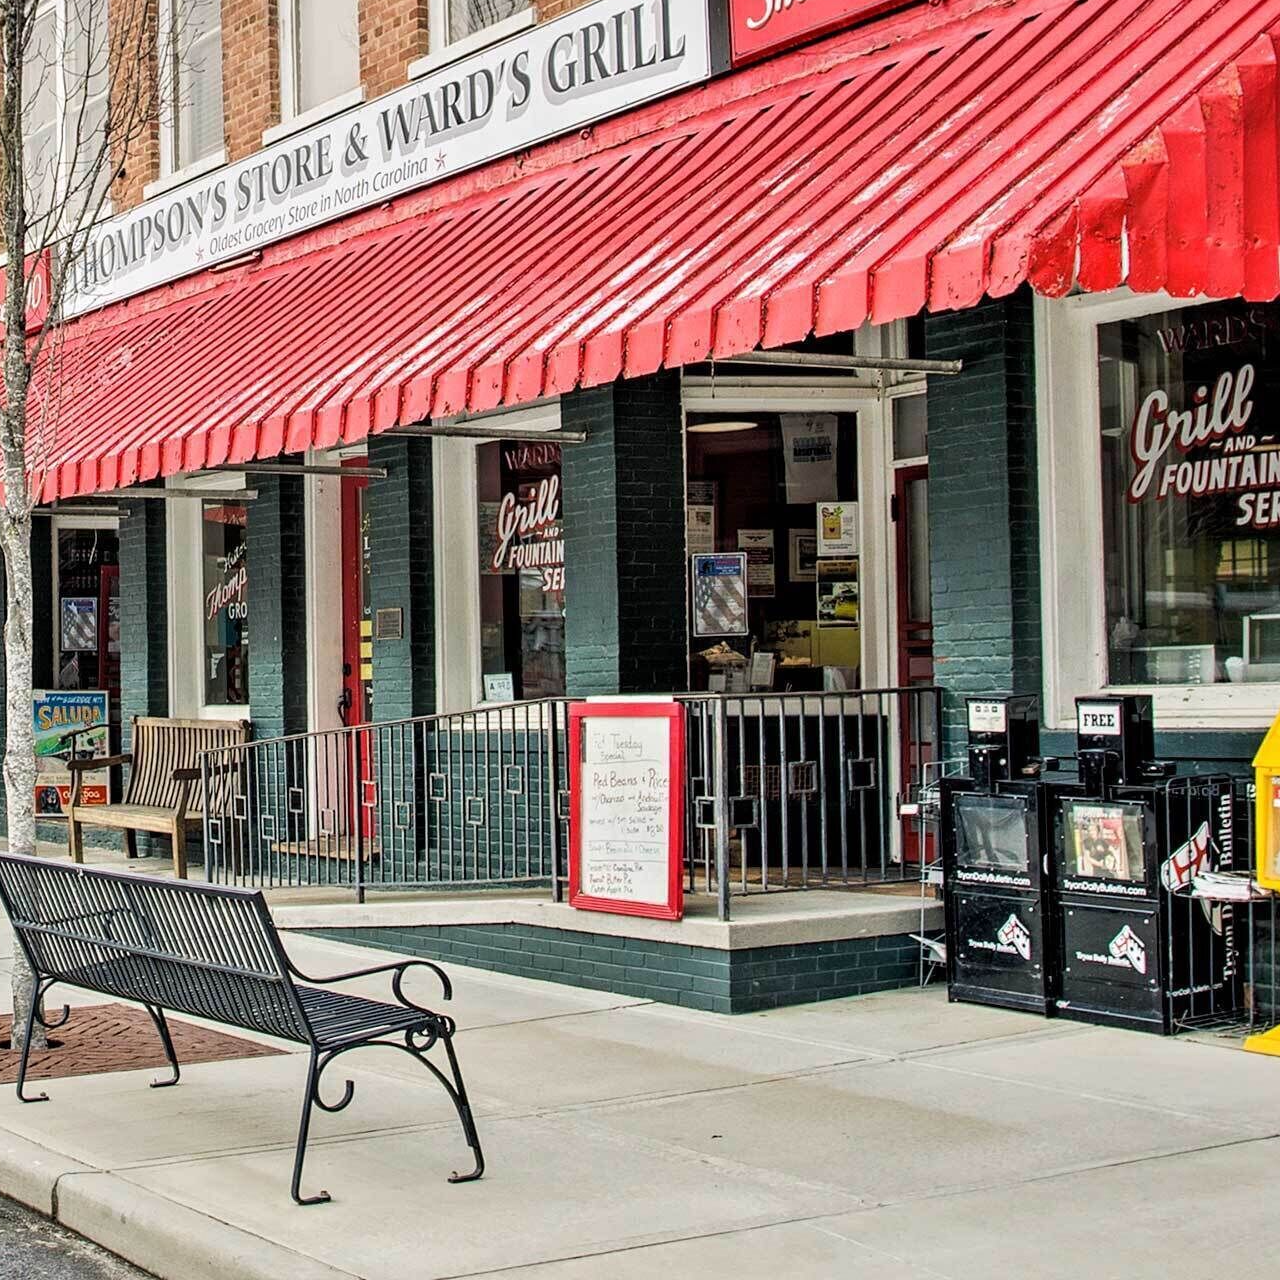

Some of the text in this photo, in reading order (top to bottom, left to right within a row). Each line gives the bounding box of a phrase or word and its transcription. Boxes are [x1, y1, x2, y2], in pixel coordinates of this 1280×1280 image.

[236, 134, 335, 212] STORE
[343, 122, 369, 167] &
[381, 50, 531, 152] WARD'S
[209, 156, 429, 256] Oldest Grocery Store in North Carolina
[1130, 362, 1256, 501] Grill
[1224, 434, 1257, 453] AND
[493, 474, 560, 569] Grill
[543, 528, 559, 539] AND
[508, 540, 564, 569] FOUNTAIN
[38, 705, 101, 730] SALUDA
[1084, 714, 1115, 728] FREE
[609, 770, 638, 789] Beans
[1218, 794, 1232, 865] Bulletin
[1064, 879, 1147, 896] TryonDailyBulletin.com
[1223, 928, 1239, 981] Tryon
